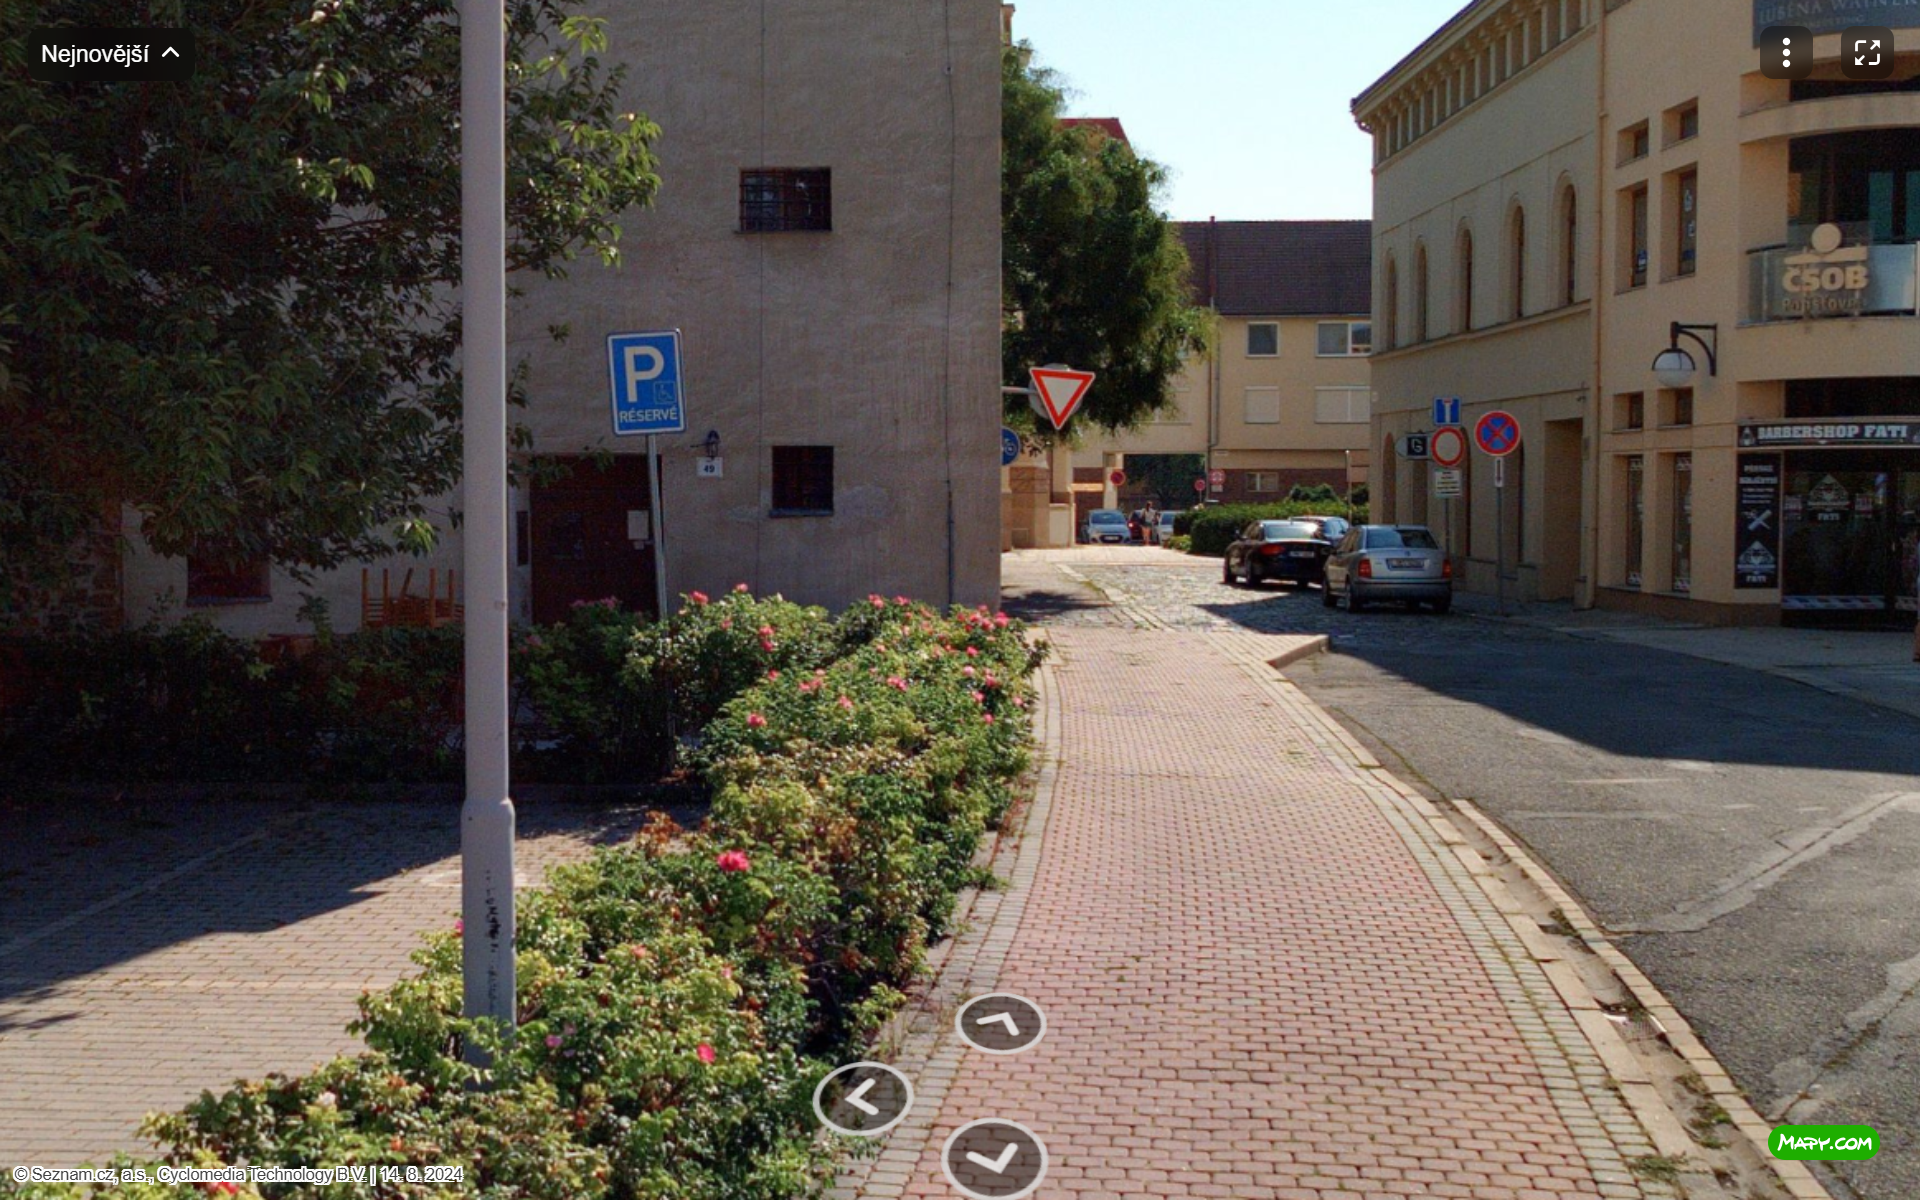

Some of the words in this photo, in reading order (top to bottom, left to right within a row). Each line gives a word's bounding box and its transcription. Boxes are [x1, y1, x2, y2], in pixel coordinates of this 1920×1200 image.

[1783, 265, 1869, 292] ČSOB
[623, 345, 665, 403] P
[619, 406, 678, 423] RÉSERVÉ
[1757, 425, 1859, 439] BARBERSHOP
[1863, 425, 1908, 438] FATI
[703, 464, 715, 473] 49
